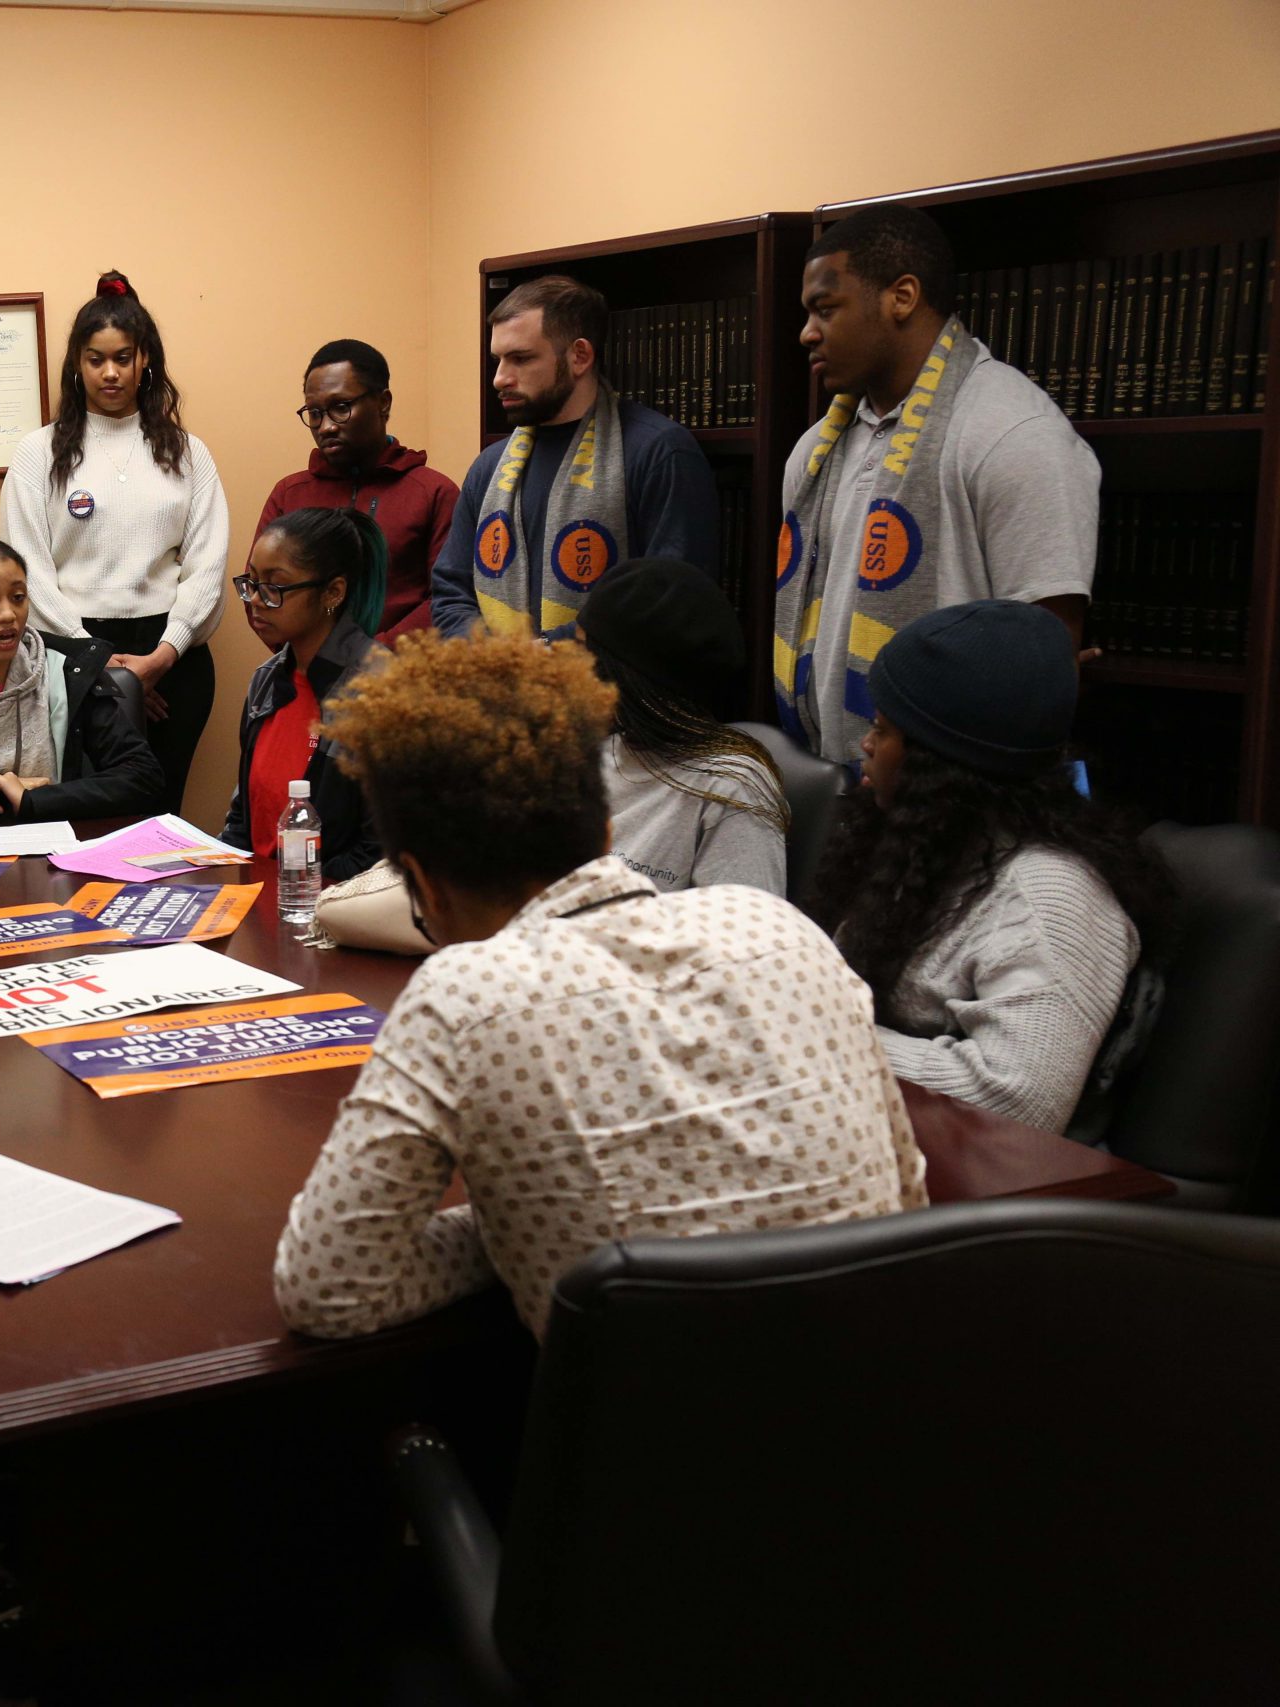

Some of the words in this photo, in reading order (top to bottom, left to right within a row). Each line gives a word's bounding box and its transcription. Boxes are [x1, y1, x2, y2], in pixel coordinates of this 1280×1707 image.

[491, 526, 501, 565] USS
[575, 535, 592, 578] USS
[865, 521, 889, 572] USS
[130, 887, 171, 916] FUNDING
[154, 893, 192, 919] TUITION
[140, 920, 169, 936] NOT
[28, 956, 104, 974] THE
[121, 1015, 304, 1045] INCREASE
[154, 1018, 200, 1029] USS
[208, 1010, 268, 1022] CUNY
[73, 1037, 208, 1061] PUBLIC
[216, 1016, 375, 1043] FUNDING
[123, 1048, 199, 1066] NOT
[208, 1027, 355, 1054] TUITION
[200, 1044, 306, 1064] #FULLYFUNDCUNY
